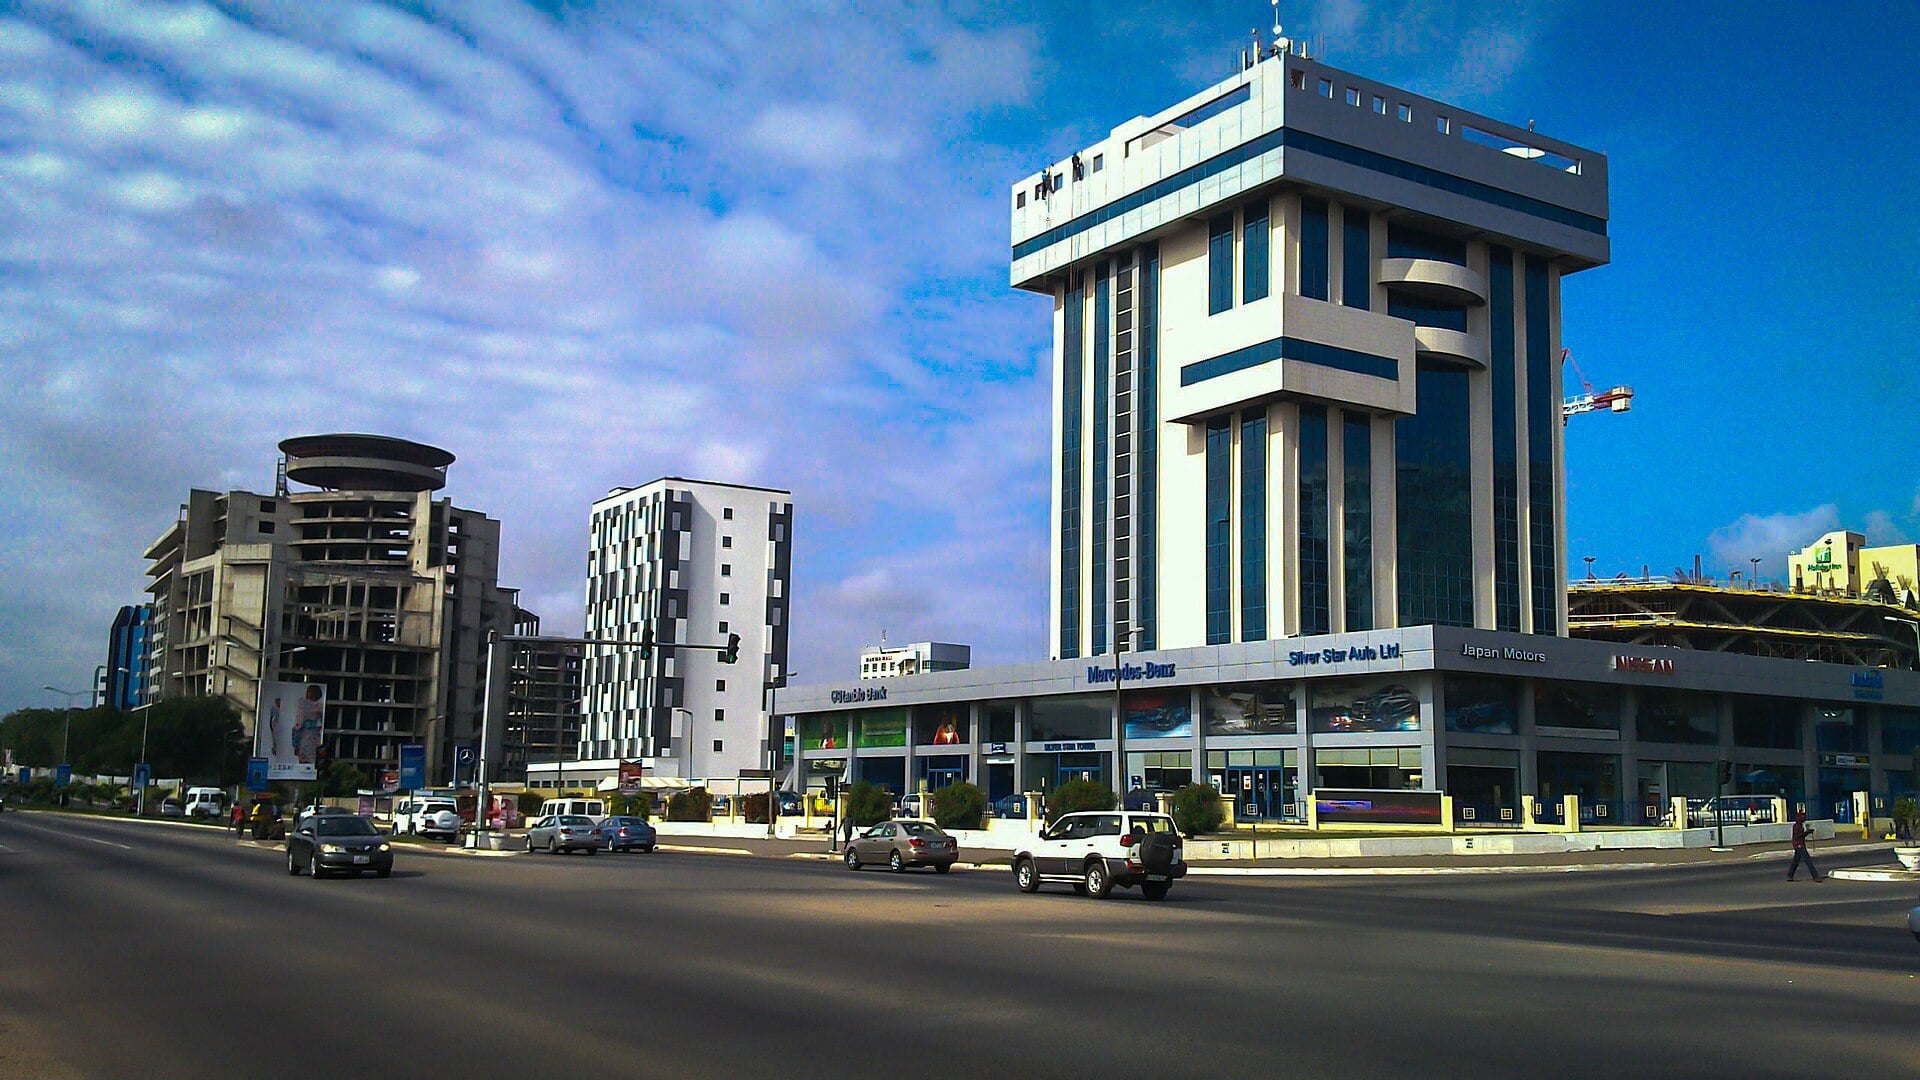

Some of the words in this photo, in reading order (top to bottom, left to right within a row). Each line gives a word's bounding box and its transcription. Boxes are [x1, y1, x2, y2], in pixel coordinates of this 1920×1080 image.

[1289, 649, 1320, 666] Silver
[1322, 648, 1347, 664] Star
[1348, 646, 1376, 661] Auto
[1379, 642, 1402, 660] Ltd.
[1463, 643, 1499, 659] Japan
[1504, 647, 1546, 663] Motors
[1612, 655, 1674, 673] NISSAN
